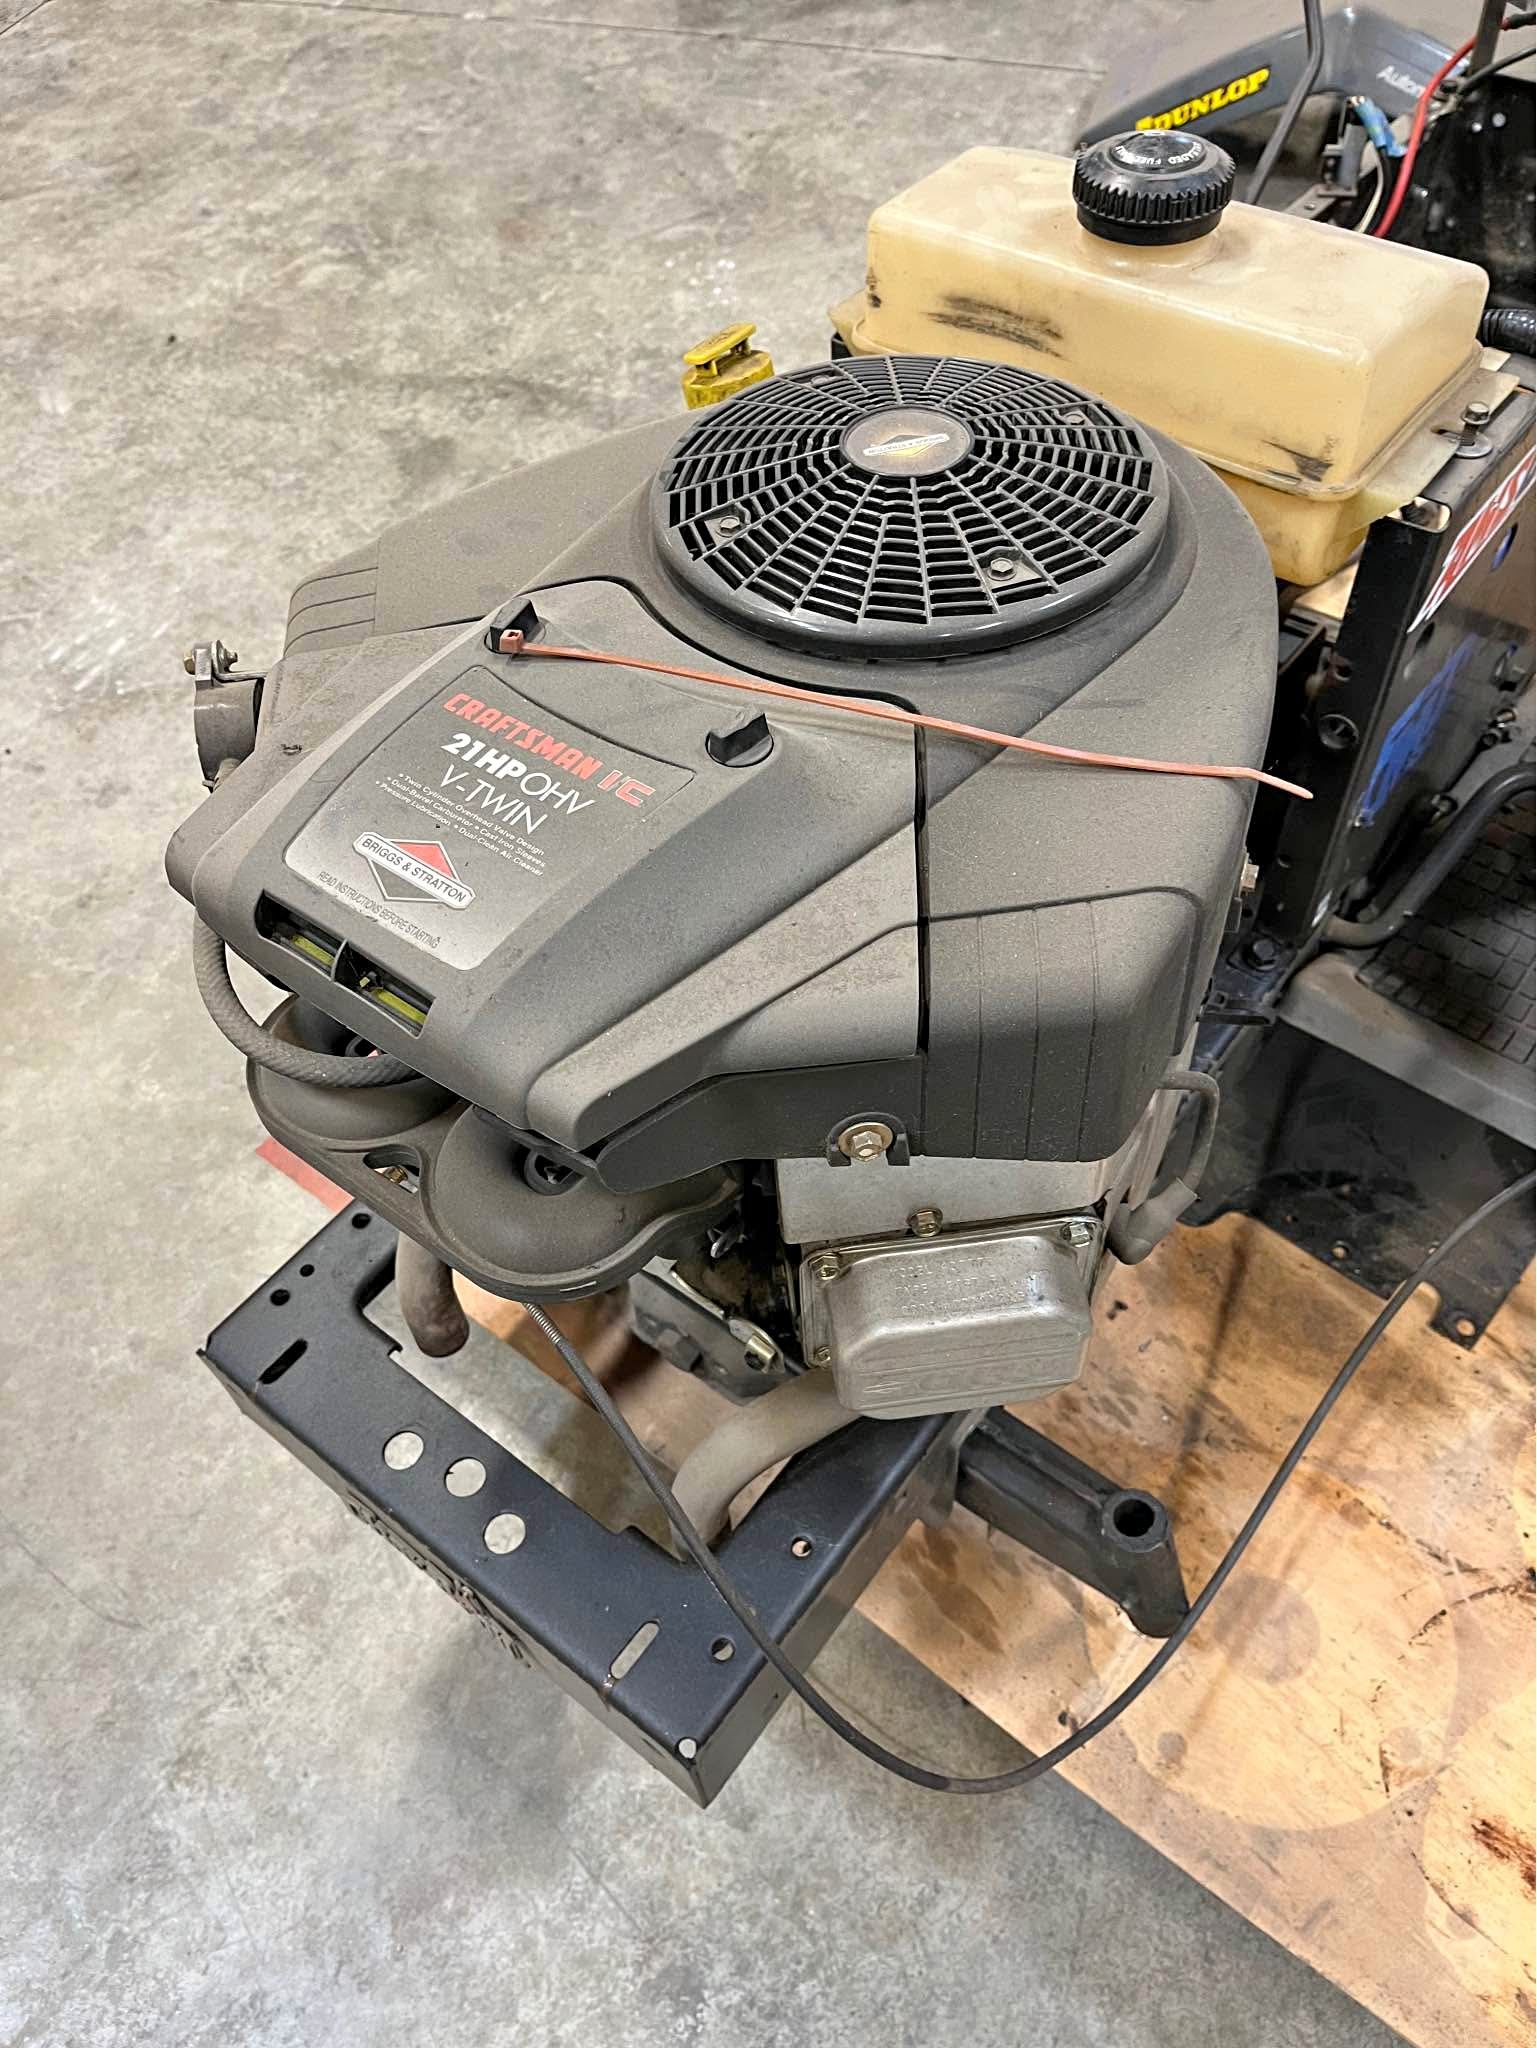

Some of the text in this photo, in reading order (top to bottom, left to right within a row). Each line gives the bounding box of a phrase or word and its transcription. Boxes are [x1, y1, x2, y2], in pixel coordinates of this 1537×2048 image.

[1153, 68, 1270, 130] DUNLOP
[442, 692, 605, 780] CRAFTSMAN
[379, 782, 545, 878] Pressure Lubrication Dual-Clean Air Cleaner
[391, 779, 547, 868] Dual-Barrel Carburetor Cast Iron Sleeves
[404, 775, 545, 857] Twin Cylinder Overhead Valve Design
[440, 763, 548, 836] V-TWIN
[318, 870, 442, 949] READ INSTRUCTIONS BEFORE STARTING
[361, 837, 468, 903] BRIGGS & STRATTON
